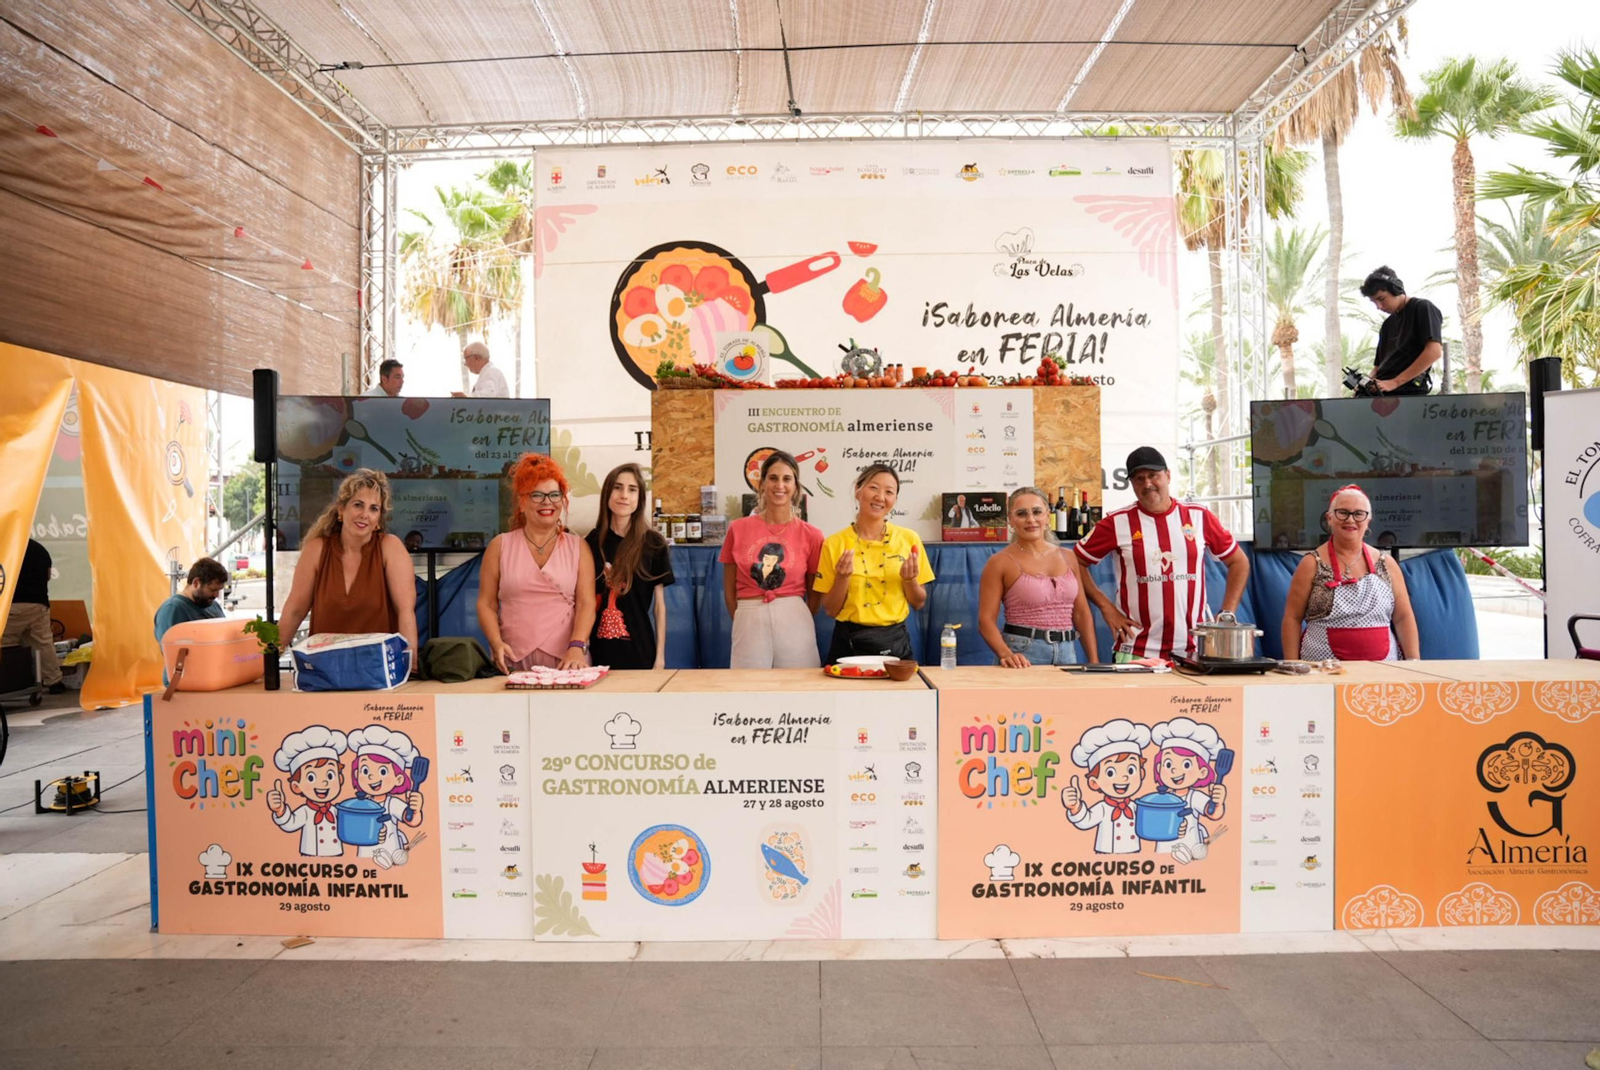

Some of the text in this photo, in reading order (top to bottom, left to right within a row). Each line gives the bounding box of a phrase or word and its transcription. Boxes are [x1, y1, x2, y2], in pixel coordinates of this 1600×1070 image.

[726, 165, 758, 176] eco
[1010, 262, 1073, 279] Las Velas
[922, 301, 1152, 328] ¡Saborea Almería
[957, 346, 989, 366] en
[450, 408, 521, 424] ¡Saborea
[748, 407, 842, 417] III ENCUENTRO DE
[1423, 403, 1497, 420] ¡Saborea
[747, 419, 933, 433] GASTRONOMÍA almeriense
[472, 435, 491, 447] en
[1446, 430, 1467, 442] en
[475, 451, 489, 459] del
[502, 451, 511, 459] al
[1450, 446, 1465, 455] del
[1480, 446, 1489, 454] al
[1565, 469, 1582, 486] EL
[1190, 704, 1221, 713] FERIA!
[384, 712, 413, 721] FERIA!
[713, 712, 832, 727] ¡Saborea Almería
[173, 719, 246, 757] mini
[730, 727, 808, 745] en FERIA!
[961, 713, 1042, 754] mini
[575, 754, 690, 771] CONCURSO
[693, 753, 717, 770] de
[542, 775, 825, 795] GASTRONOMÍA ALMERIENSE
[1252, 786, 1276, 795] eco
[449, 795, 473, 803] eco
[743, 798, 825, 811] 27 y 28 agosto
[851, 793, 876, 802] eco
[1466, 828, 1588, 864] Almería
[236, 862, 377, 879] IX CONCURSO DE
[1024, 860, 1175, 877] IX CONCURSO DE
[188, 878, 409, 899] GASTRONOMÍA INFANTIL
[971, 877, 1206, 898] GASTRONOMÍA INFANTIL
[279, 902, 331, 913] 29 agosto
[1069, 901, 1124, 913] 29 agosto
